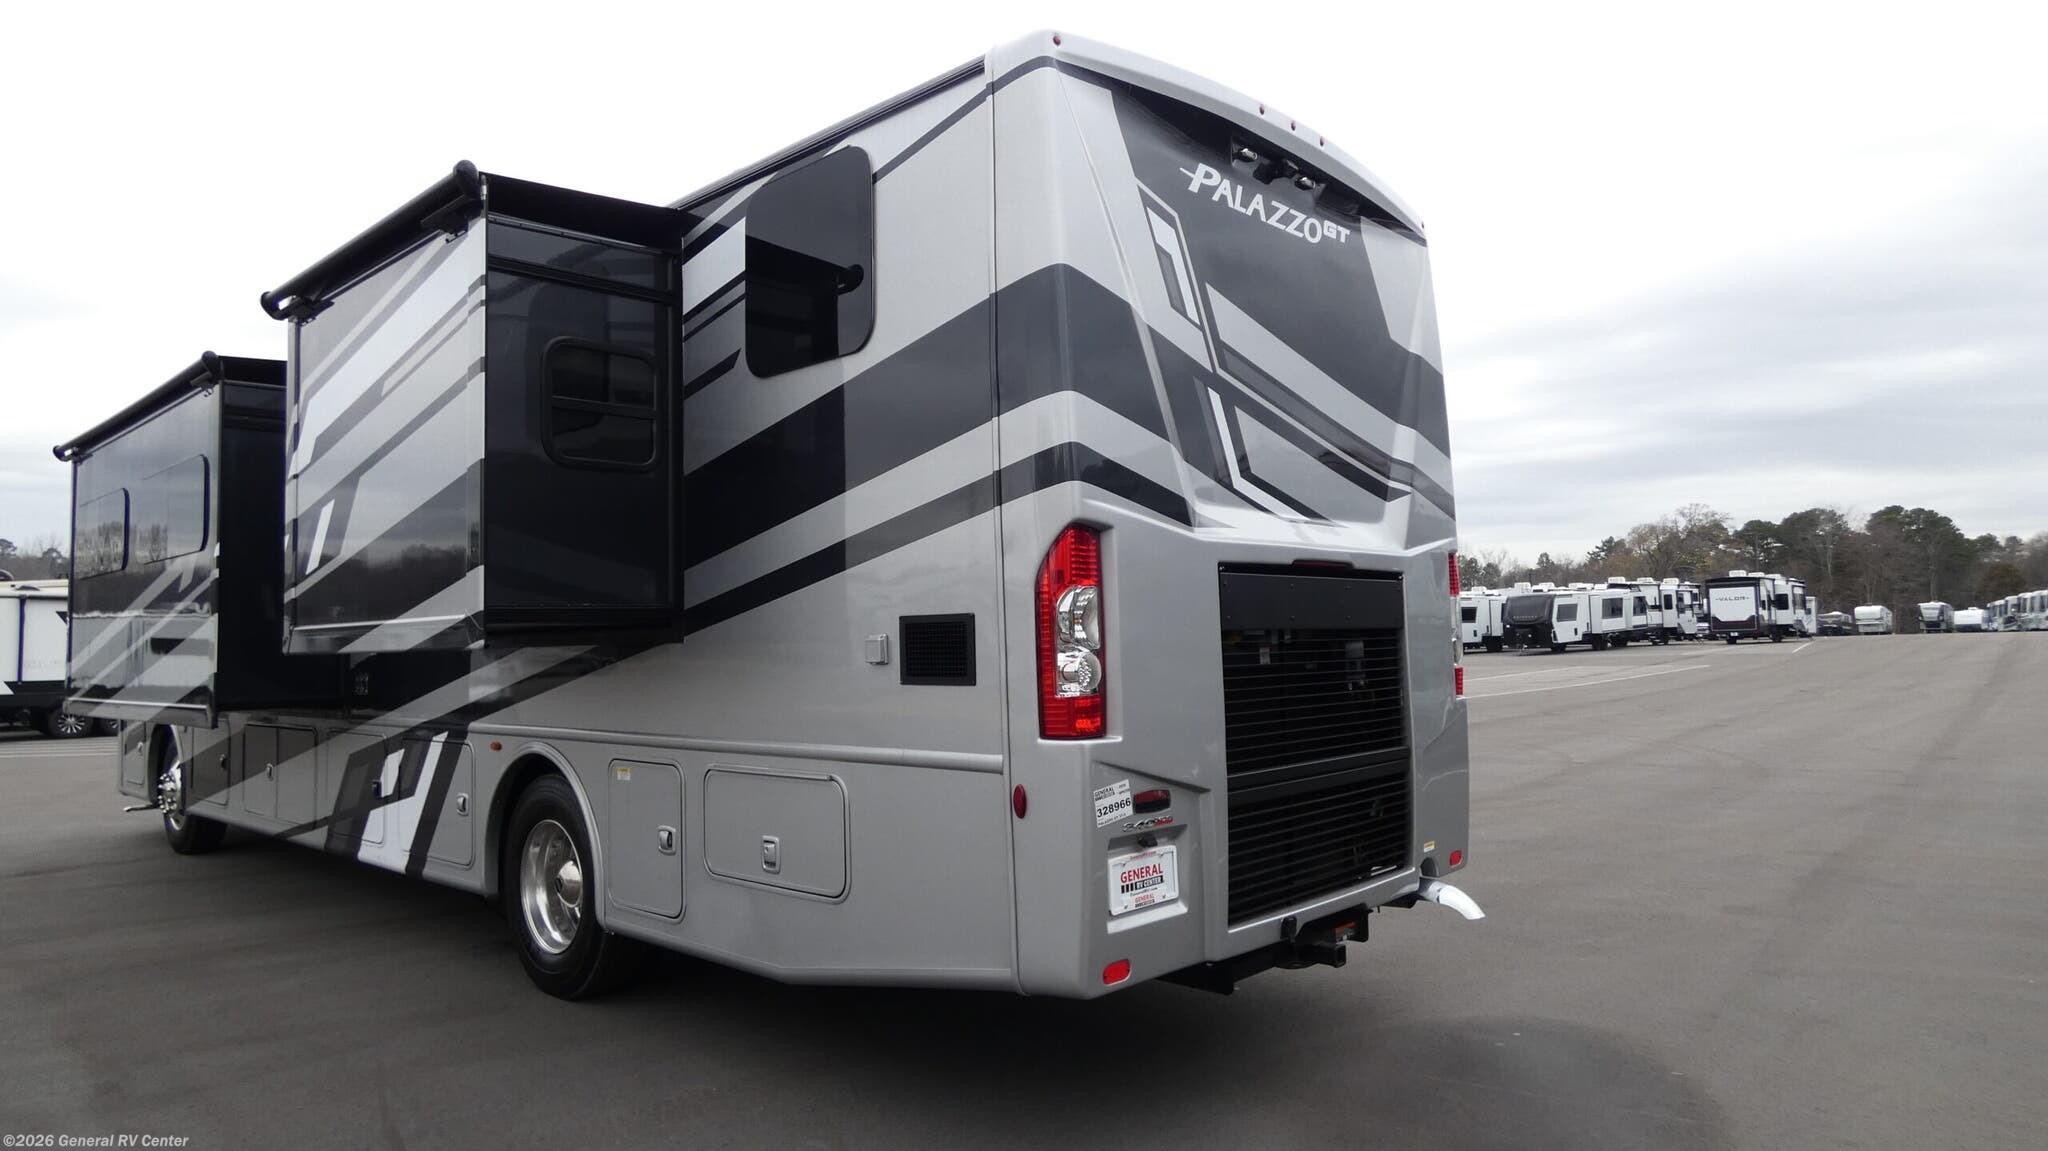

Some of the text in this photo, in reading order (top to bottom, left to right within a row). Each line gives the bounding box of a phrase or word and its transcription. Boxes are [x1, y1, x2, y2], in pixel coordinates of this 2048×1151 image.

[1180, 163, 1350, 243] PALAZZO GT
[1097, 797, 1131, 818] 328966
[1120, 863, 1163, 883] GENERAL
[1136, 877, 1162, 889] RV CENTER
